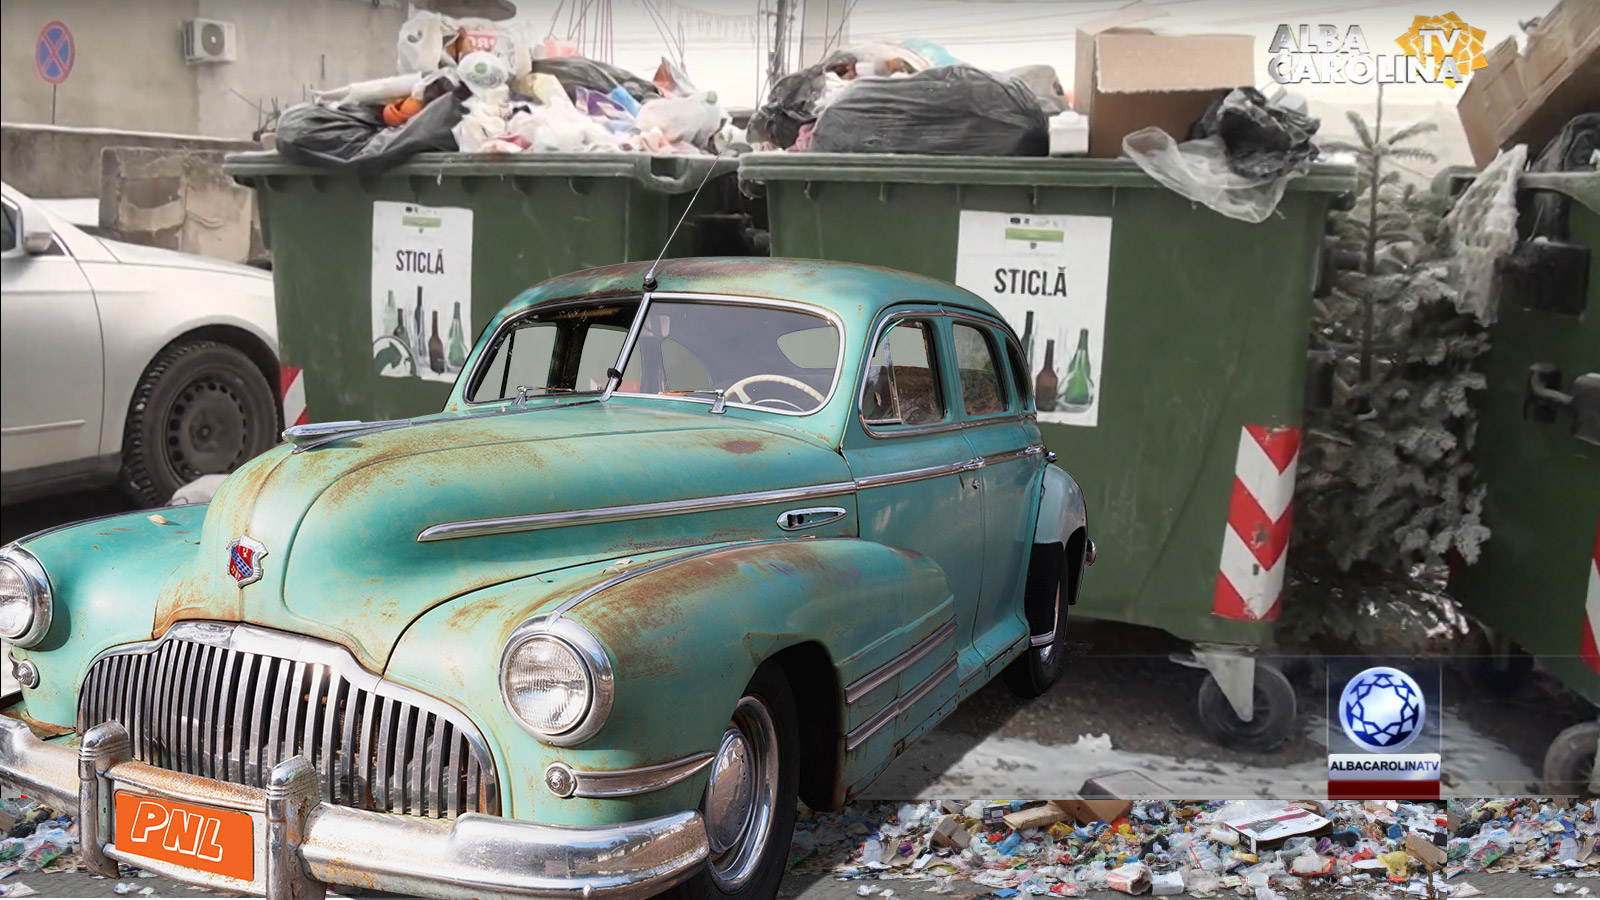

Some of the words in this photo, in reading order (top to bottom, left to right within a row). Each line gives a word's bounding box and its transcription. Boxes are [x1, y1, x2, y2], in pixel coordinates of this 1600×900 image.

[395, 248, 445, 274] STICLĂ
[994, 266, 1067, 297] STICLĂ
[130, 801, 224, 863] PNL
